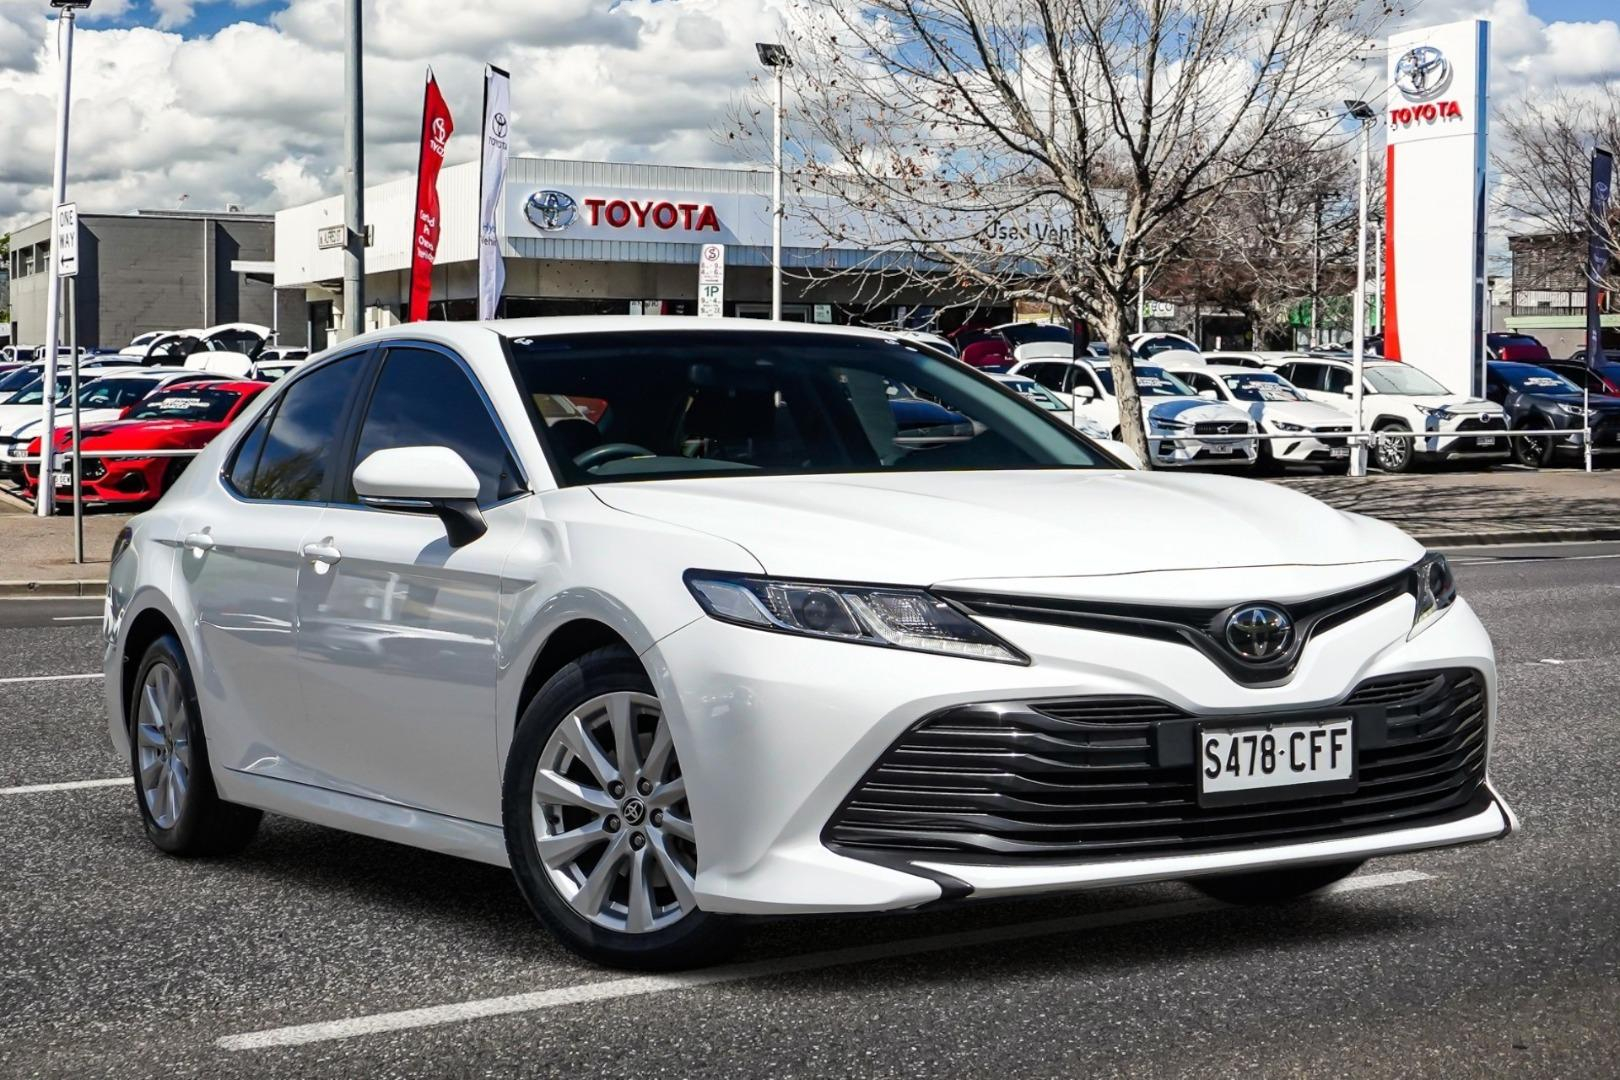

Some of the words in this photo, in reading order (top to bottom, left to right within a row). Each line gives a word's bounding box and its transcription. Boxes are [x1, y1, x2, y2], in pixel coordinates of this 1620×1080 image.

[1389, 101, 1462, 124] TOYOTA
[60, 210, 74, 227] ONE
[584, 198, 720, 231] TOYOTA
[984, 221, 1030, 240] Used
[60, 231, 75, 249] WAY
[703, 285, 720, 297] 1P
